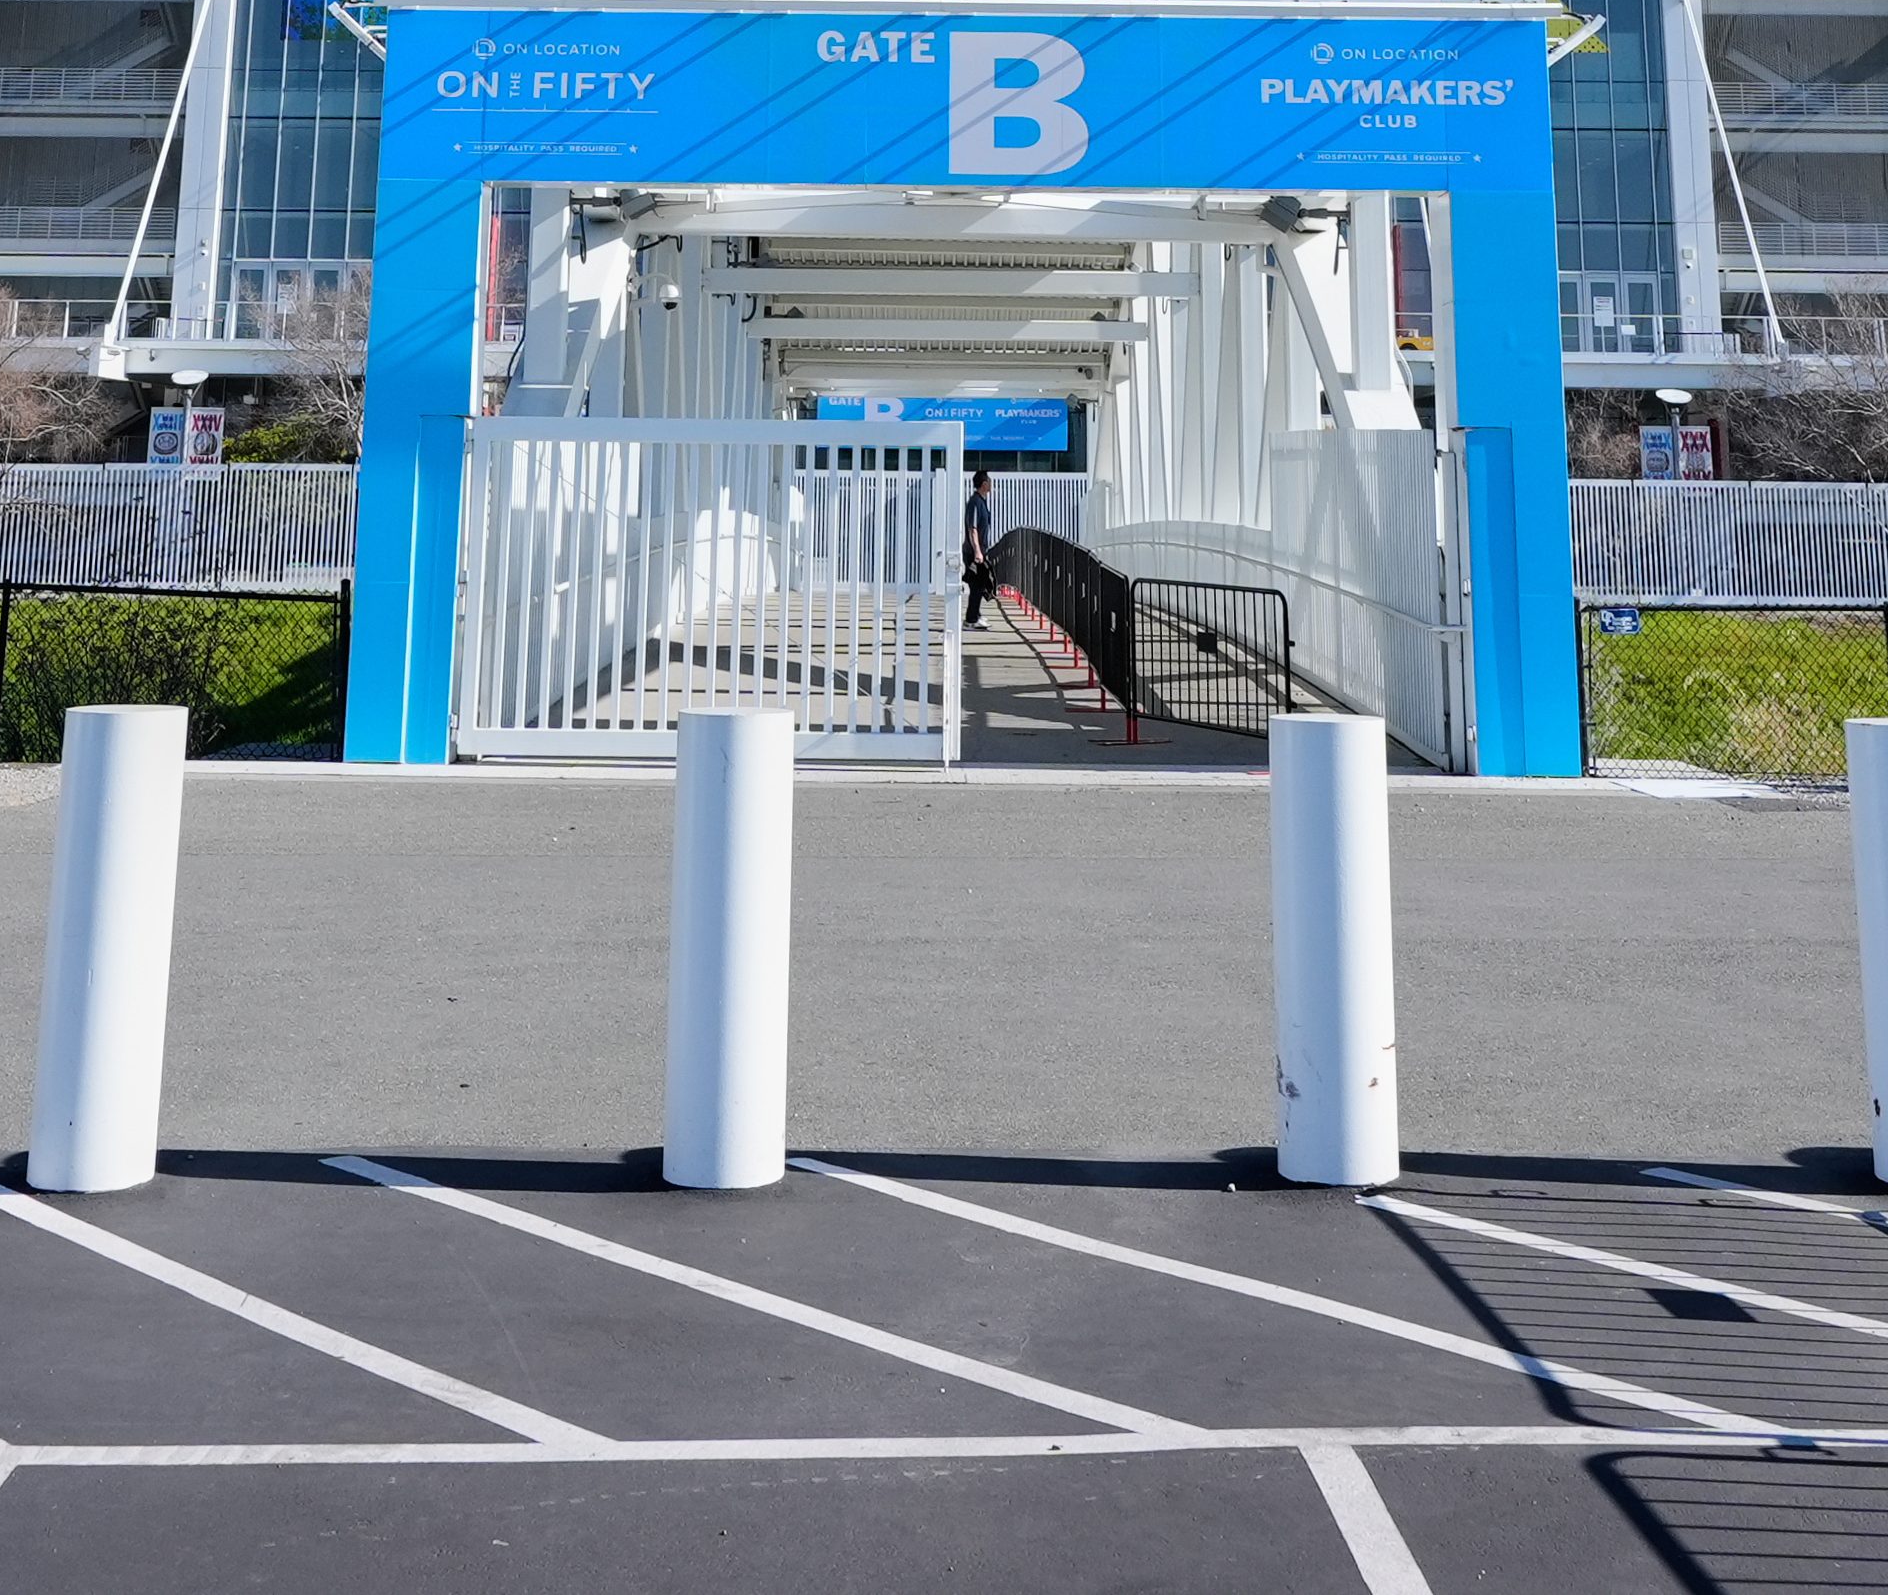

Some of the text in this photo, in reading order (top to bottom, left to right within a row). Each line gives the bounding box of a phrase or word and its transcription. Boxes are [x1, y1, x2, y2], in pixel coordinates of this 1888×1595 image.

[503, 43, 620, 56] ON LOCATION
[1341, 47, 1459, 61] ON LOCATION
[436, 70, 656, 100] ON THE FIFTY
[1260, 78, 1514, 106] PLAYMAKERS'
[816, 30, 1089, 176] GATE B
[1359, 114, 1418, 128] CLUB
[473, 143, 618, 153] HOSPITALITY PASS REQUIRED
[1317, 153, 1462, 163] HOSPITALITY PASS REQUIRED
[828, 396, 861, 406] GATE
[925, 408, 943, 418] ON
[950, 408, 984, 418] FIFTY
